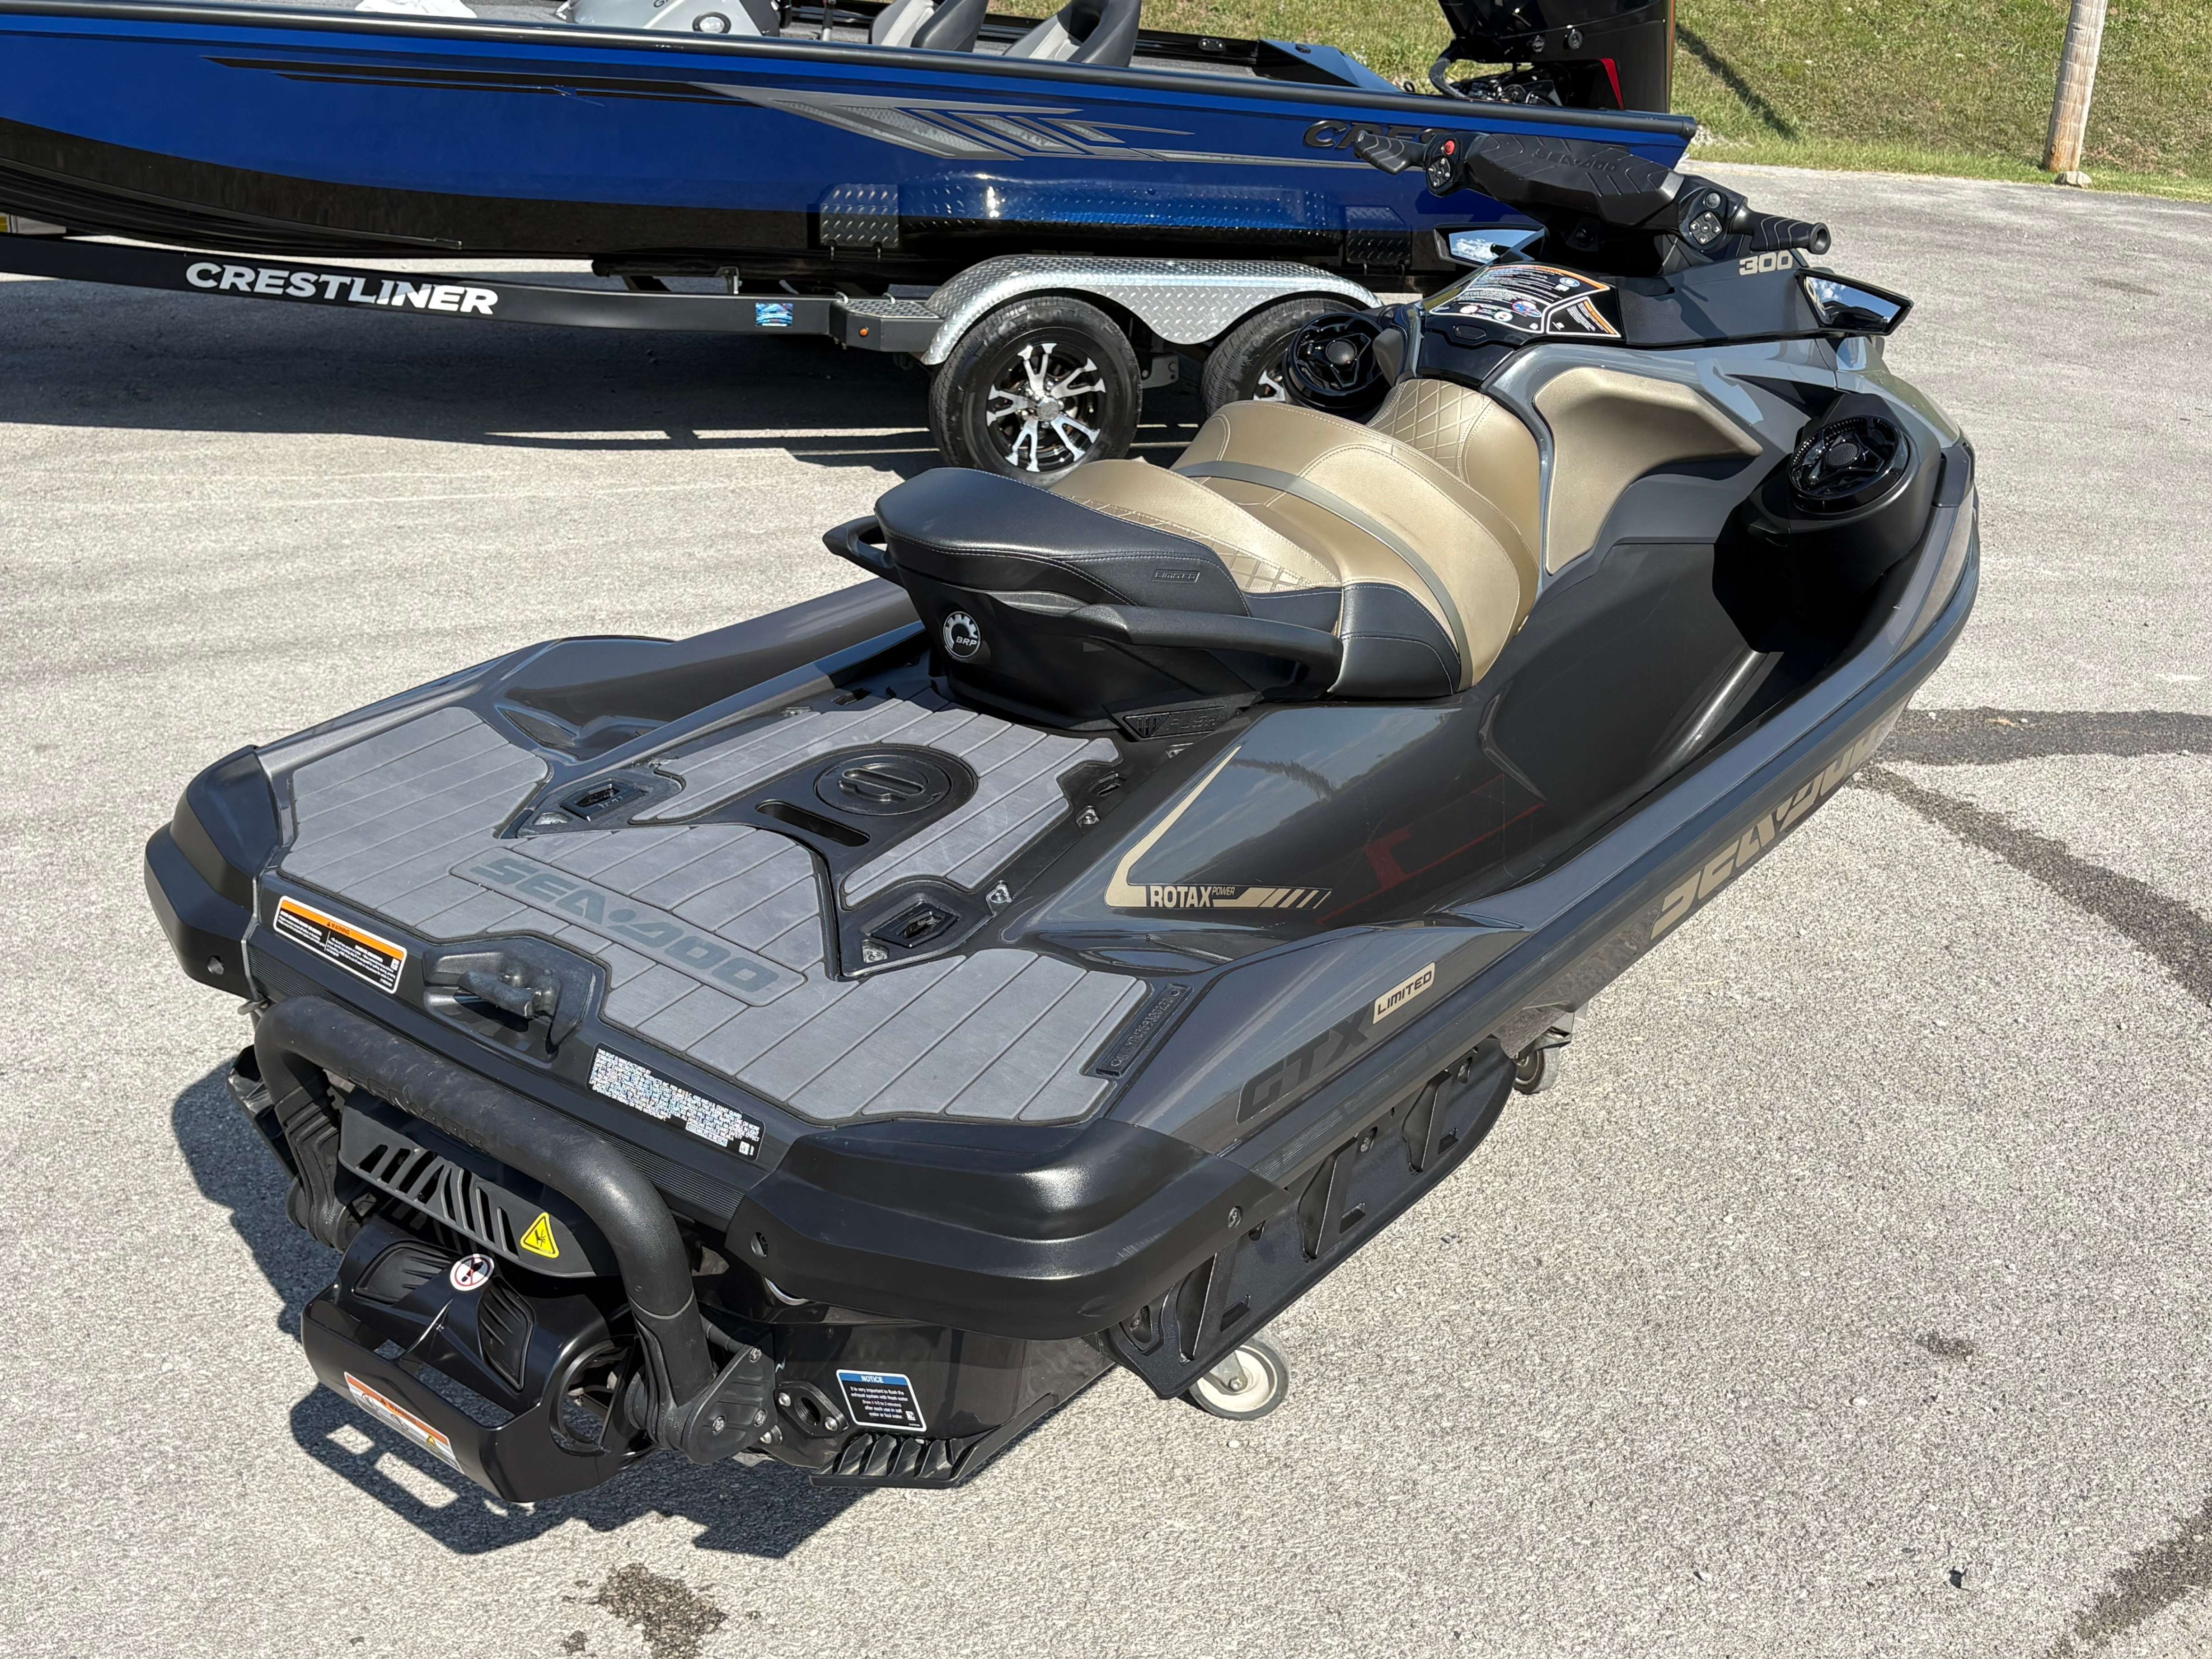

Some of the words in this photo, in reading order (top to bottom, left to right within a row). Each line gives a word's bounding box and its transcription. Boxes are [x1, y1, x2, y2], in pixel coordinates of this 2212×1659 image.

[1739, 251, 1793, 276] 300
[185, 262, 498, 315] CRESTLINER
[956, 636, 977, 647] BRP
[1150, 885, 1213, 908] ROTAX
[1212, 886, 1236, 896] POWER
[1378, 970, 1432, 1016] LIMITED
[1237, 1004, 1371, 1125] GTX
[861, 1375, 885, 1383] NOTICE
